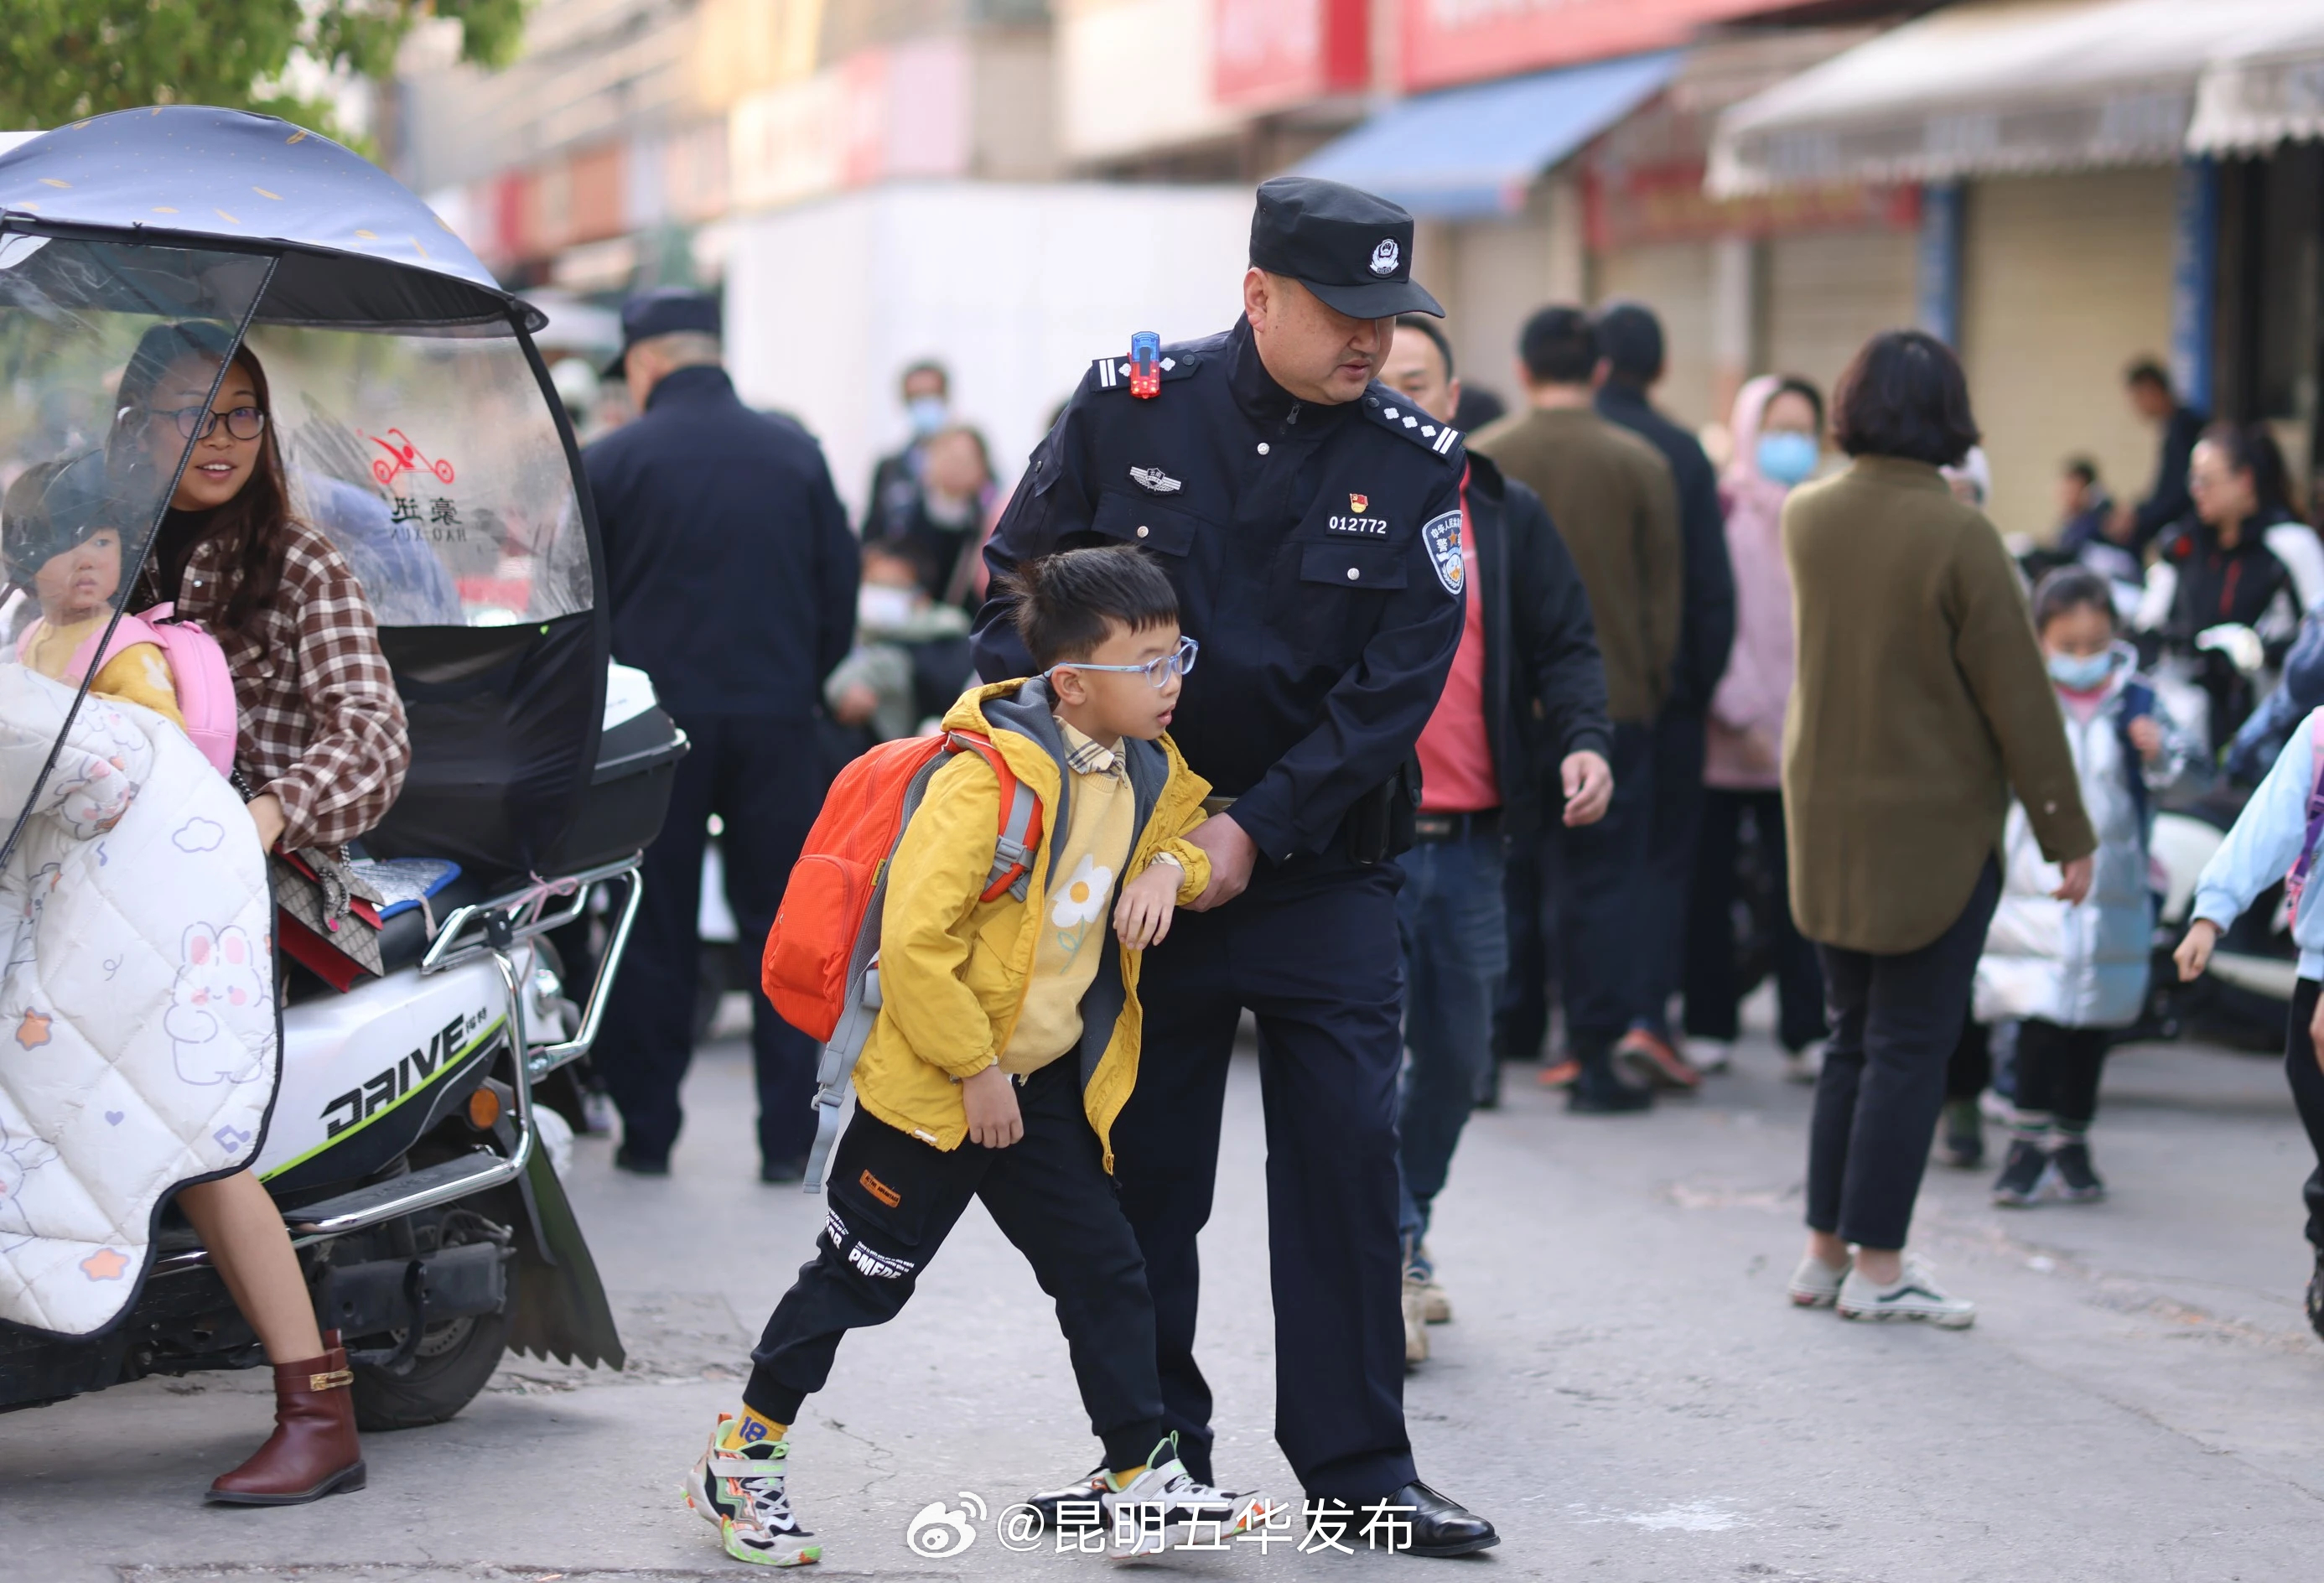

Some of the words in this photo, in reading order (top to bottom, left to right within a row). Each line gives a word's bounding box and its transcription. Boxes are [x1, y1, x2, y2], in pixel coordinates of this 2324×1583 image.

[1329, 516, 1388, 534] 012772
[319, 1013, 468, 1140] DRIVE
[739, 1415, 768, 1443] 18
